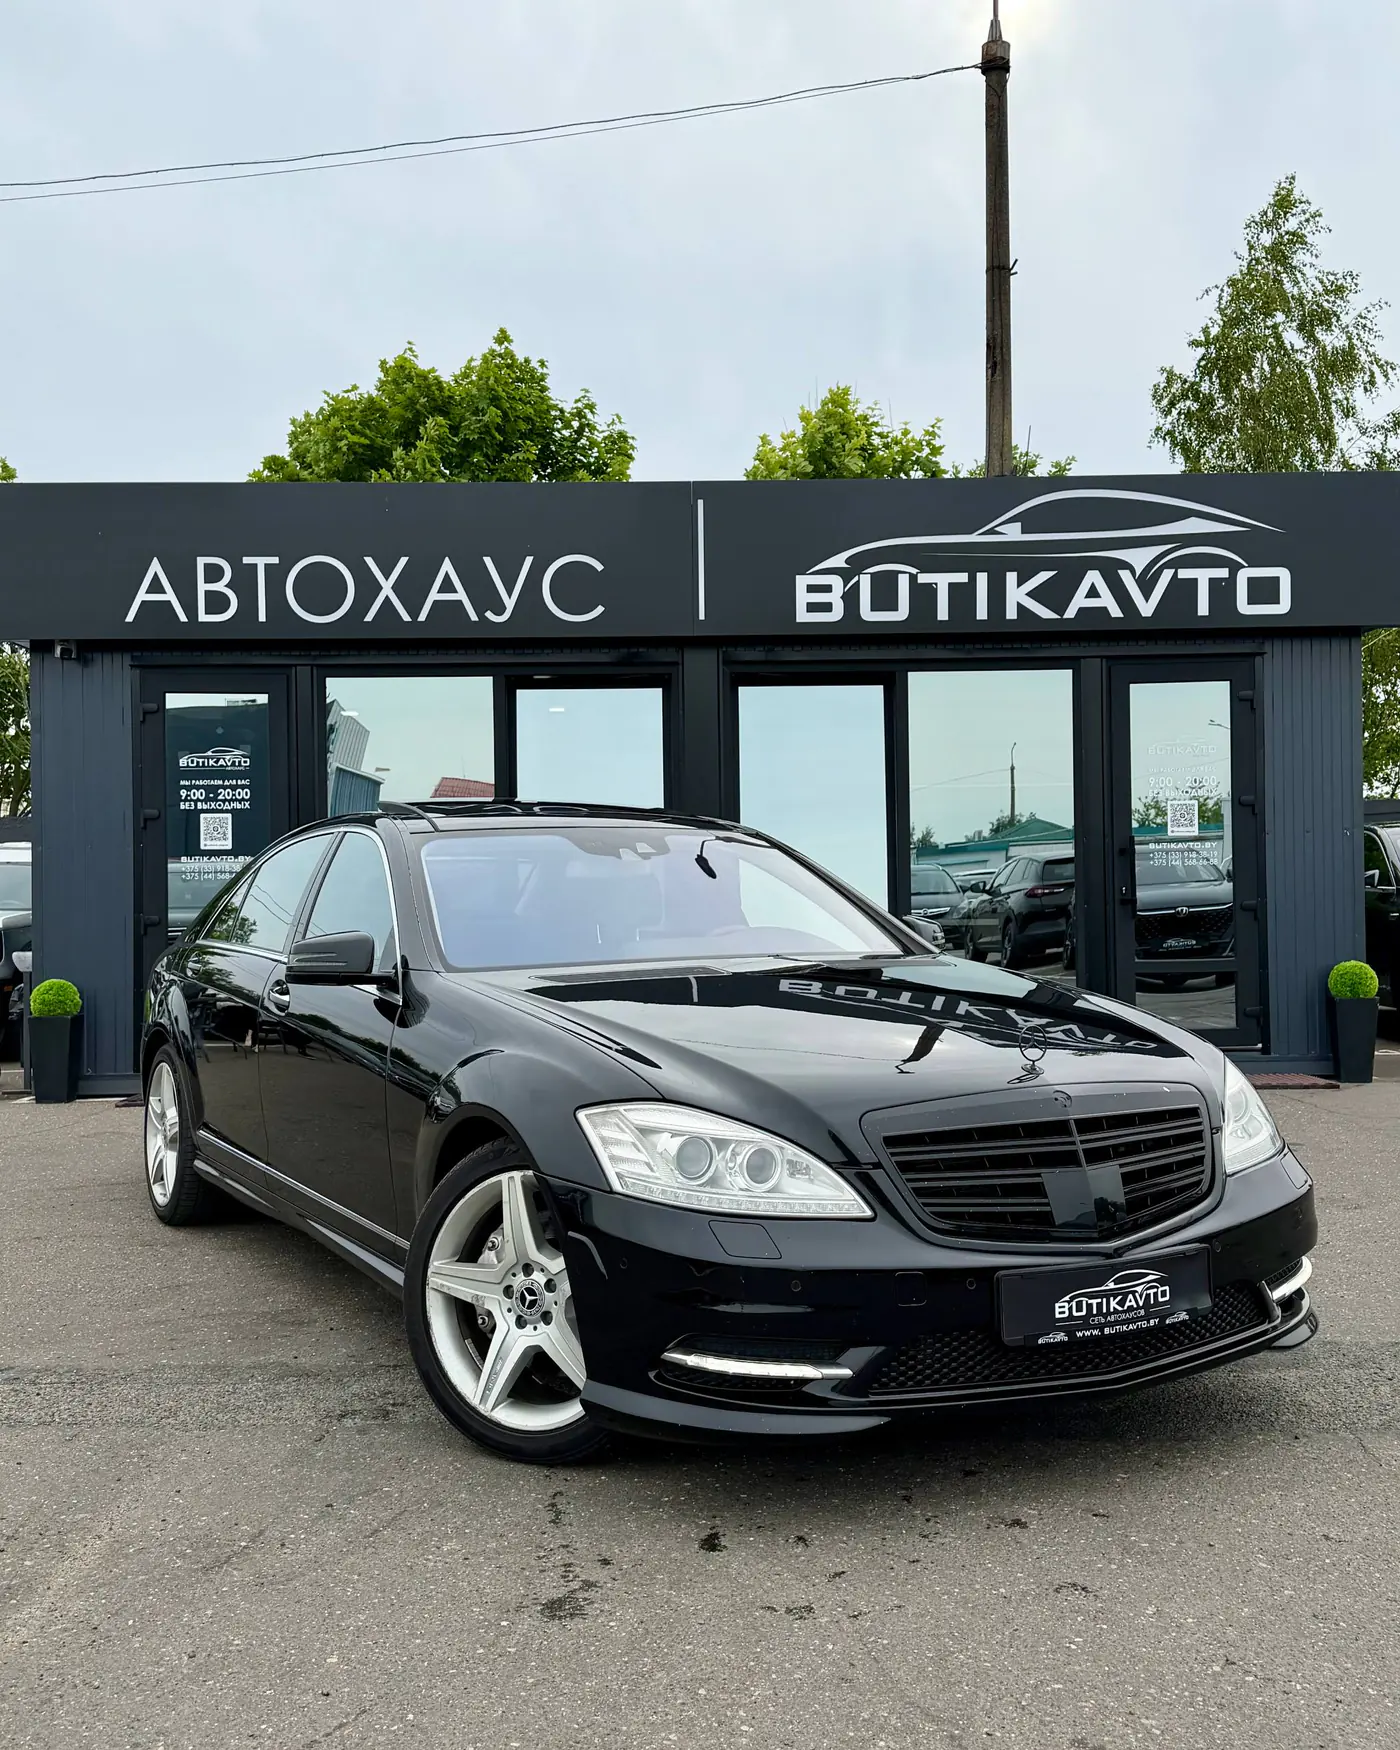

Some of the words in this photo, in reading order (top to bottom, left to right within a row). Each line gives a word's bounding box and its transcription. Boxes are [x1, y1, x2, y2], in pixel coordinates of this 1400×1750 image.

[125, 554, 605, 623] АВТОХАУС
[796, 566, 1291, 622] BUTIKAVTO
[179, 758, 250, 767] BUTIKAVTO
[1149, 777, 1173, 787] 9:00
[1185, 775, 1217, 786] 20:00
[180, 789, 206, 800] 9:00
[217, 788, 251, 800] 20:00
[180, 801, 195, 810] БЕЗ
[197, 801, 251, 810] ВЫХОДНЫХ
[1169, 851, 1182, 860] (33)
[201, 865, 215, 873] (33)
[1169, 859, 1182, 867] (44)
[181, 872, 199, 880] +375
[201, 872, 215, 881] (44)
[1054, 1285, 1170, 1319] BUTIKAVTO
[1089, 1316, 1106, 1325] СЕТЬ
[1106, 1308, 1146, 1322] АВТОХАУСОВ
[1075, 1328, 1102, 1338] WWW.
[1103, 1317, 1160, 1335] BUTIKAVTO.BY
